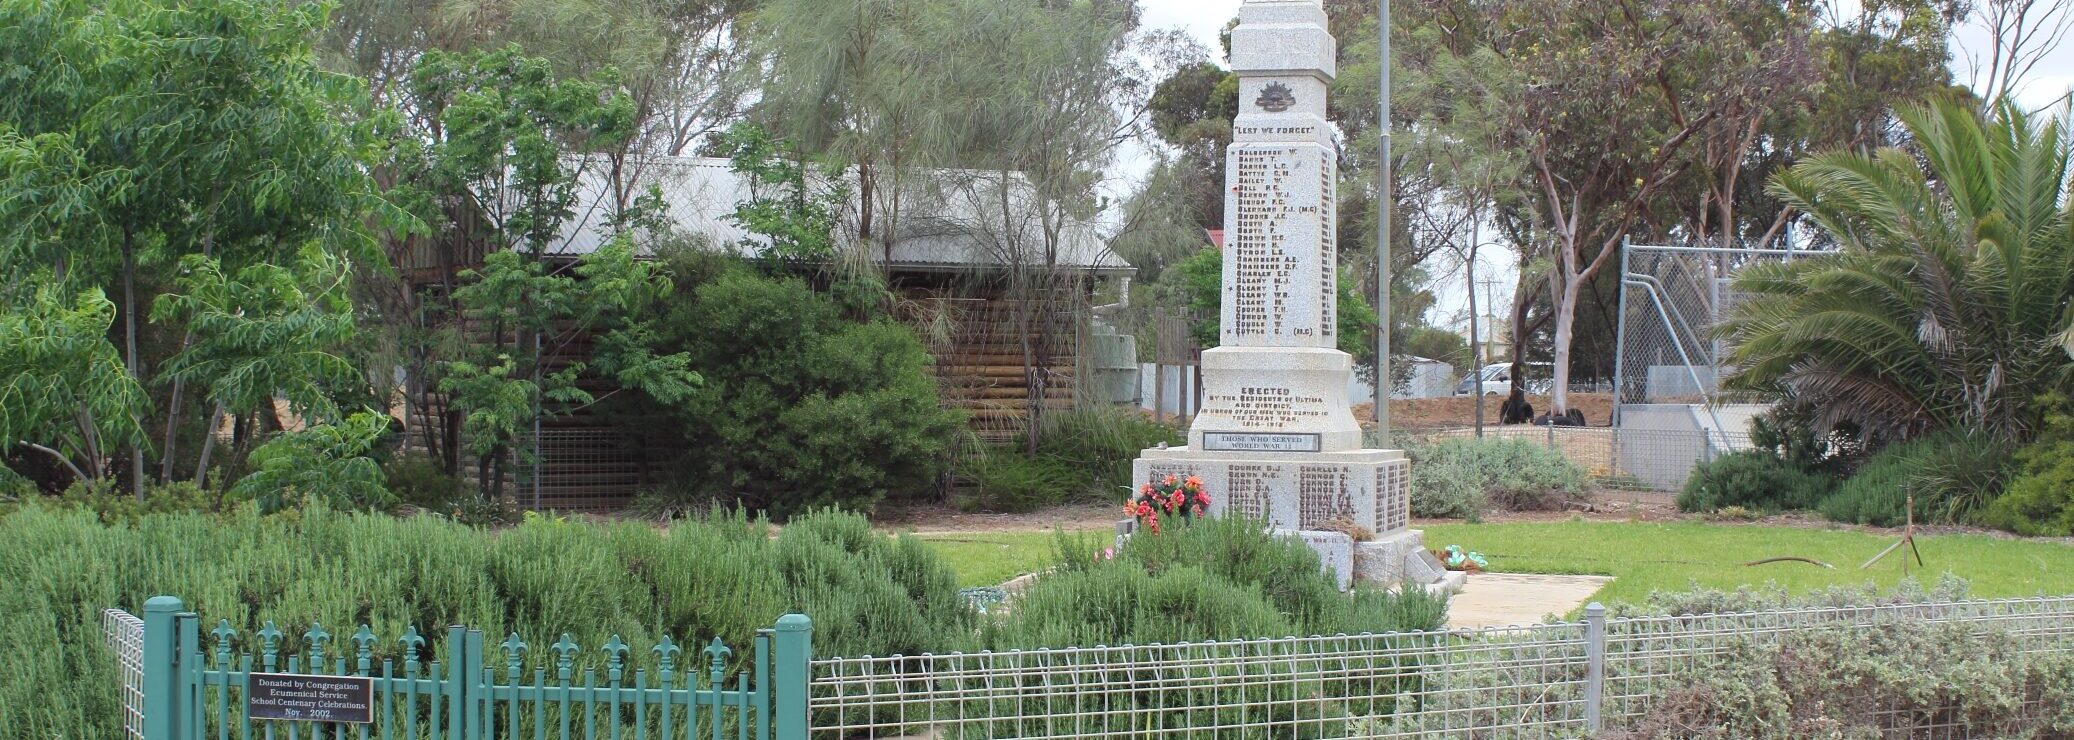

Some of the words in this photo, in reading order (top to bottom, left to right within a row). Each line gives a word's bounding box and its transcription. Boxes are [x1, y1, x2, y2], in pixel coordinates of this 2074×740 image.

[259, 679, 292, 687] Donated
[294, 680, 304, 688] by
[306, 681, 359, 690] Congregation
[270, 689, 317, 697] Ecumenical
[319, 691, 348, 699] Service
[278, 699, 316, 708] Centenary
[318, 700, 367, 710] Celebrations.
